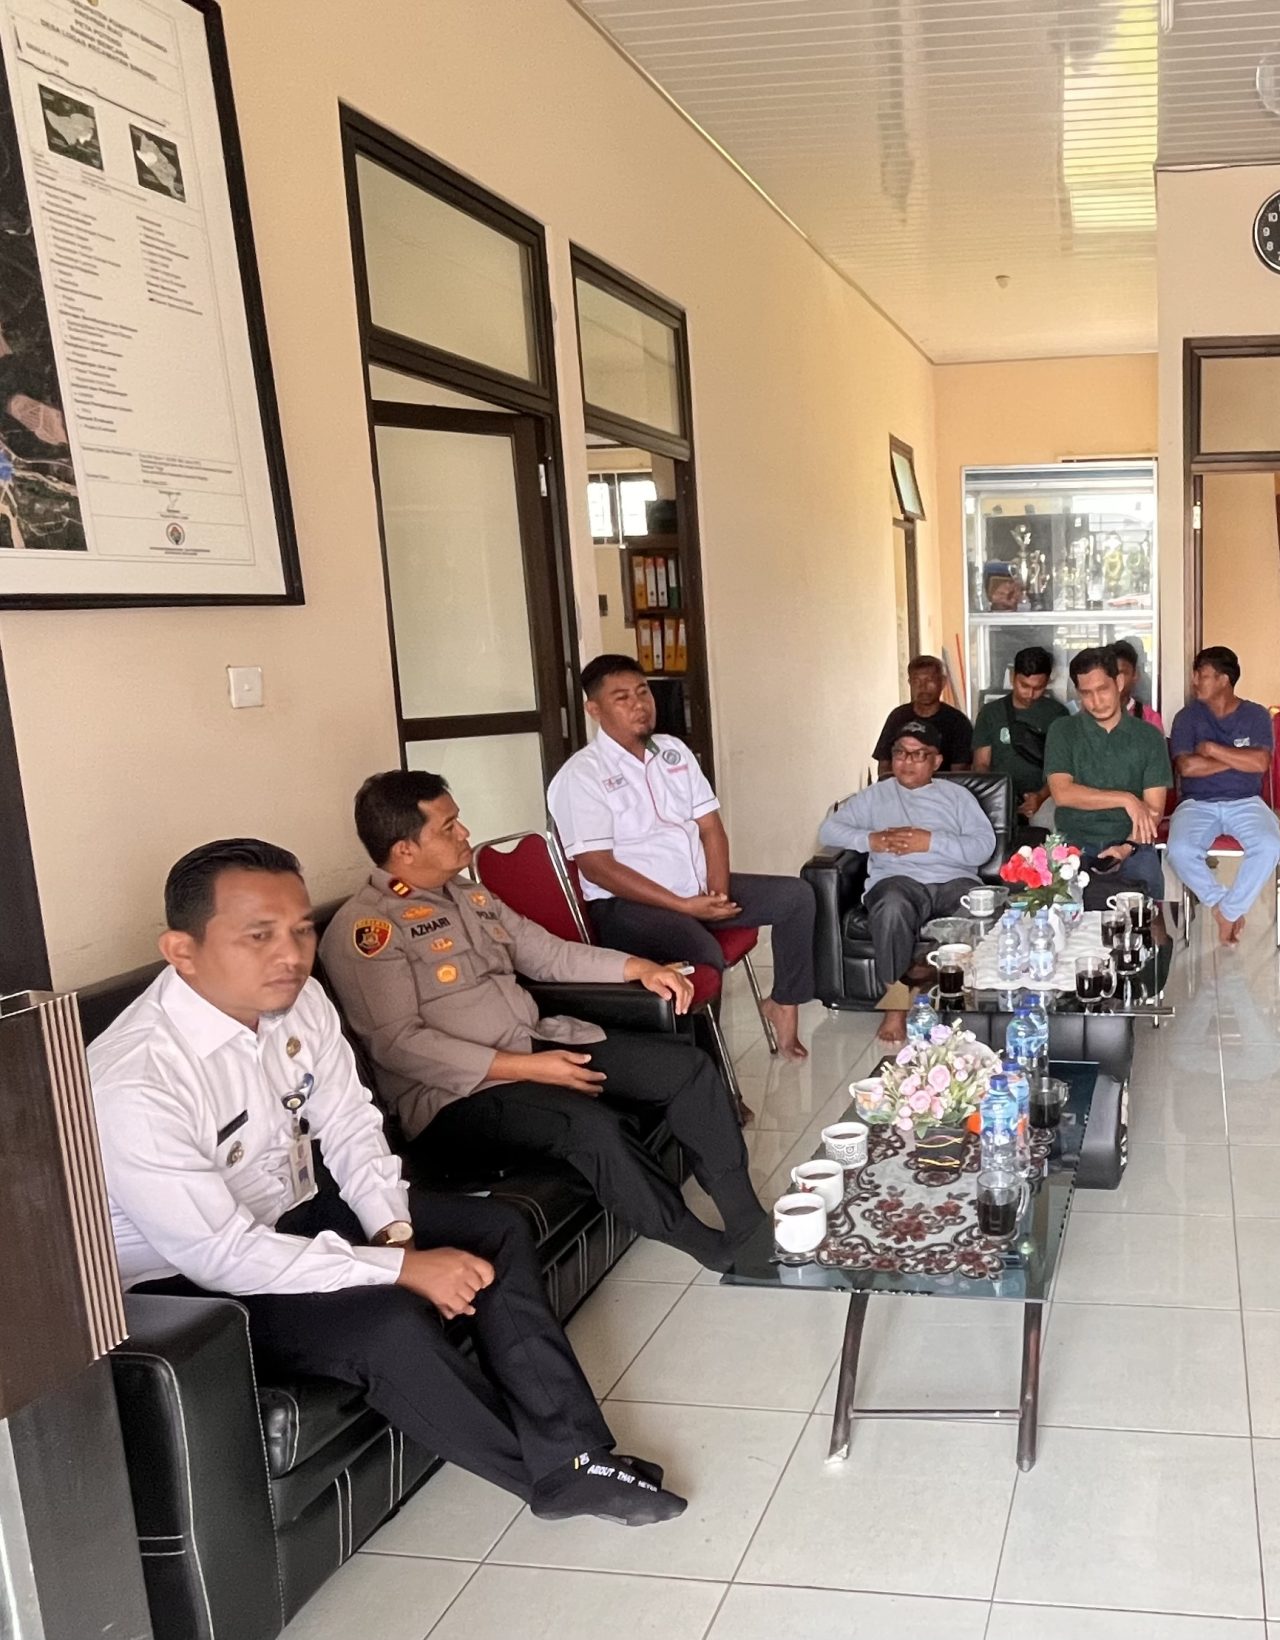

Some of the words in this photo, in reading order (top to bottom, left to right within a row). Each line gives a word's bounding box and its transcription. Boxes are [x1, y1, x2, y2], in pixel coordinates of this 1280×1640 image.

[1268, 212, 1278, 222] 10
[1263, 227, 1270, 236] 9
[1266, 241, 1274, 251] 8
[410, 917, 451, 938] AZHARI
[587, 1464, 615, 1477] ABOUT
[617, 1471, 635, 1484] THAT
